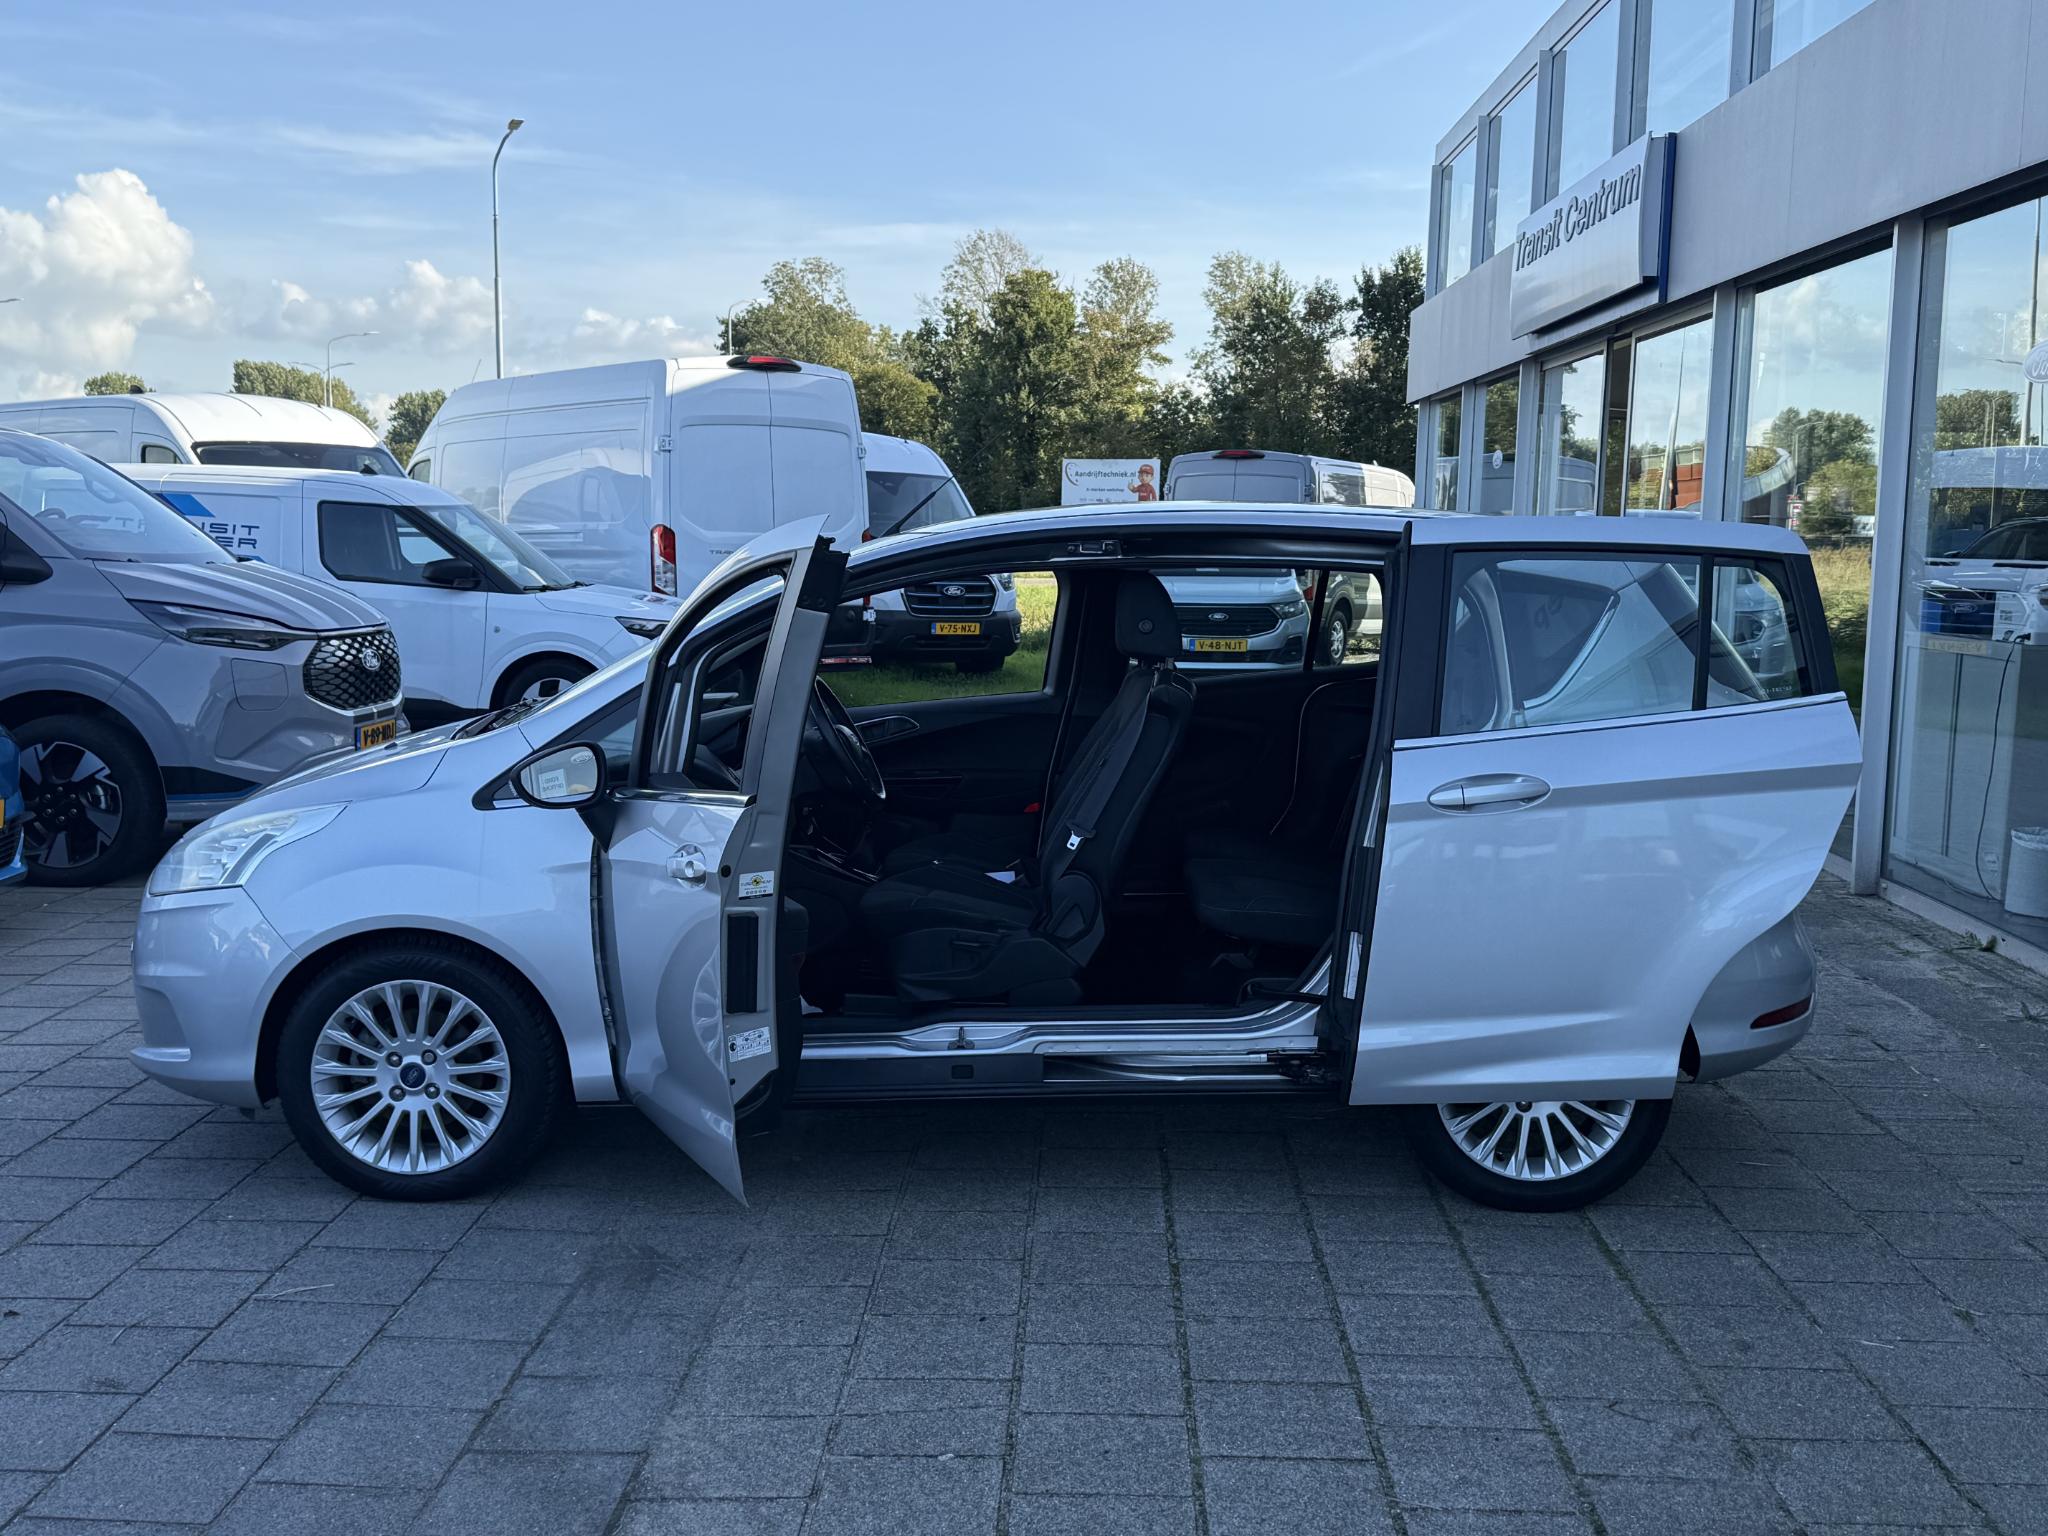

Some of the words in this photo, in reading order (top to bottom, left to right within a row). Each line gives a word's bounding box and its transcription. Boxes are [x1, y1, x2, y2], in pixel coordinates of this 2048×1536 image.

[1515, 207, 1563, 271] Transit
[1564, 163, 1641, 242] Centrum
[1074, 470, 1137, 478] Aandrijftechniek.nl
[939, 624, 977, 633] V-75-NXJ
[1198, 641, 1244, 650] V-48-NJT
